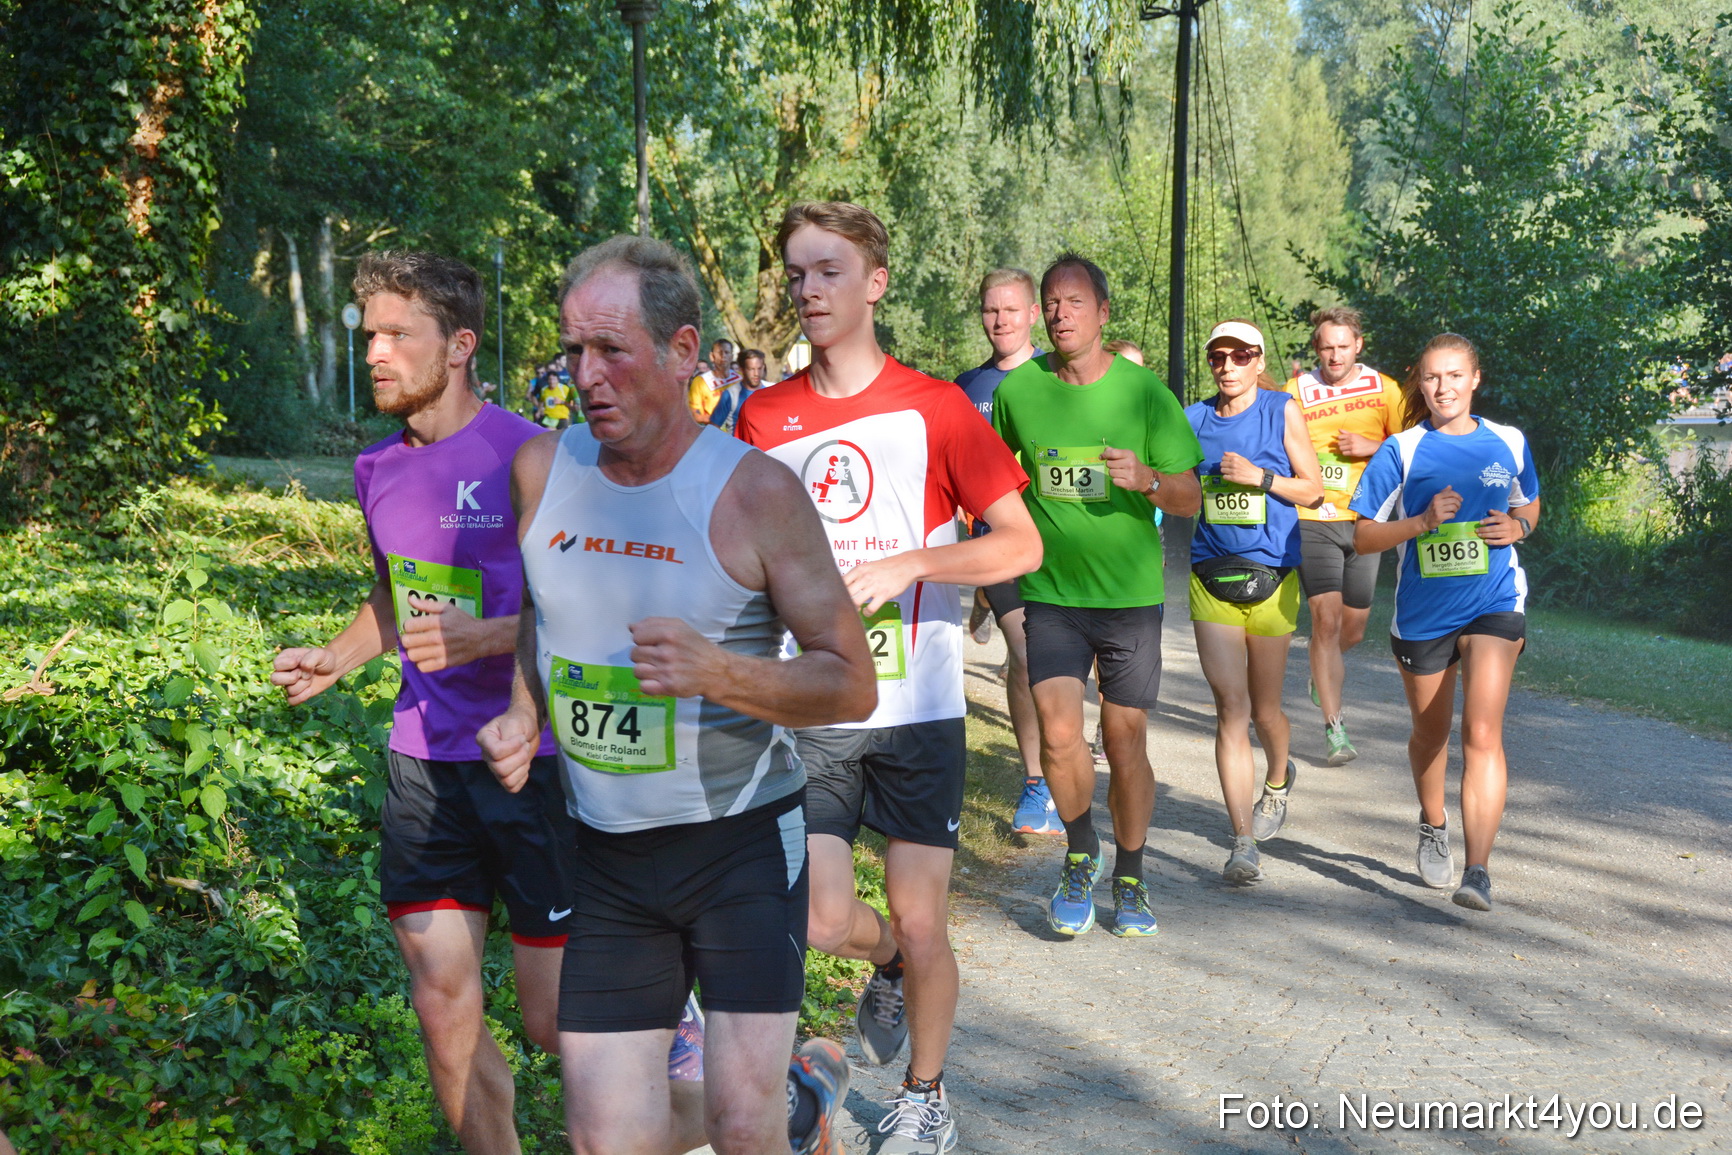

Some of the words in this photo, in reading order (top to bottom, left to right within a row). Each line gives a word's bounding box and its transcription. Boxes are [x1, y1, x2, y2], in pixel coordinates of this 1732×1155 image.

[1303, 406, 1339, 422] MAX
[1344, 398, 1385, 413] BÖGL
[1050, 466, 1092, 487] 913
[456, 480, 483, 510] K
[1215, 492, 1249, 510] 666
[439, 513, 504, 523] KÜFNER
[583, 536, 684, 564] KLEBL
[833, 539, 859, 550] MIT
[1426, 540, 1479, 563] 1968
[838, 558, 853, 567] Dr.
[571, 699, 642, 744] 874
[570, 736, 608, 752] Blomeier
[610, 743, 647, 756] Roland
[586, 751, 602, 760] Klebl
[603, 753, 624, 763] GmbH
